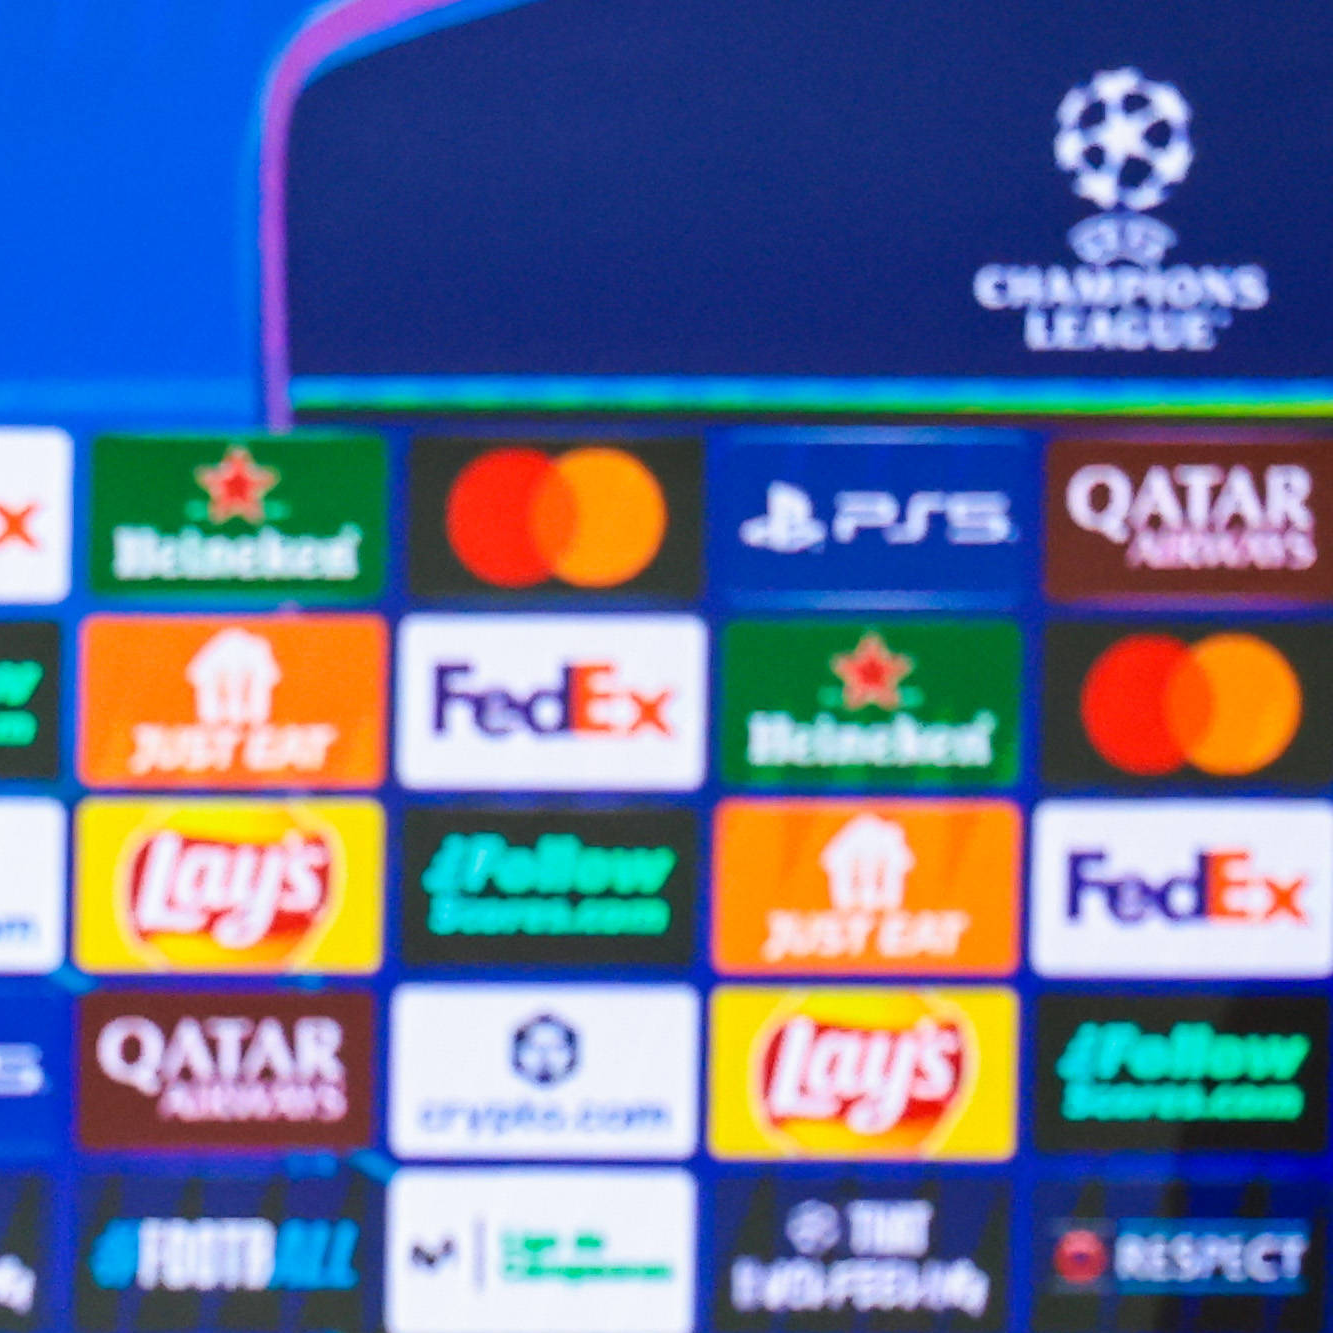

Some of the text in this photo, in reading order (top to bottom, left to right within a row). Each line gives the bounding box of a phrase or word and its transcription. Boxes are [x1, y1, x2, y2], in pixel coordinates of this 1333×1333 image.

[833, 492, 1010, 544] PS5
[1067, 466, 1311, 545] QATAR
[114, 528, 359, 580] Heineken
[432, 662, 670, 739] FedEx
[129, 723, 336, 774] JUST EAT
[749, 713, 993, 766] Heineken
[138, 830, 329, 948] Lay's
[1065, 850, 1304, 926] FedEx
[763, 910, 970, 962] JUST EAT
[98, 1018, 344, 1096] QATAR
[765, 1015, 961, 1134] Lay's
[1114, 1234, 1306, 1282] RESPECT
